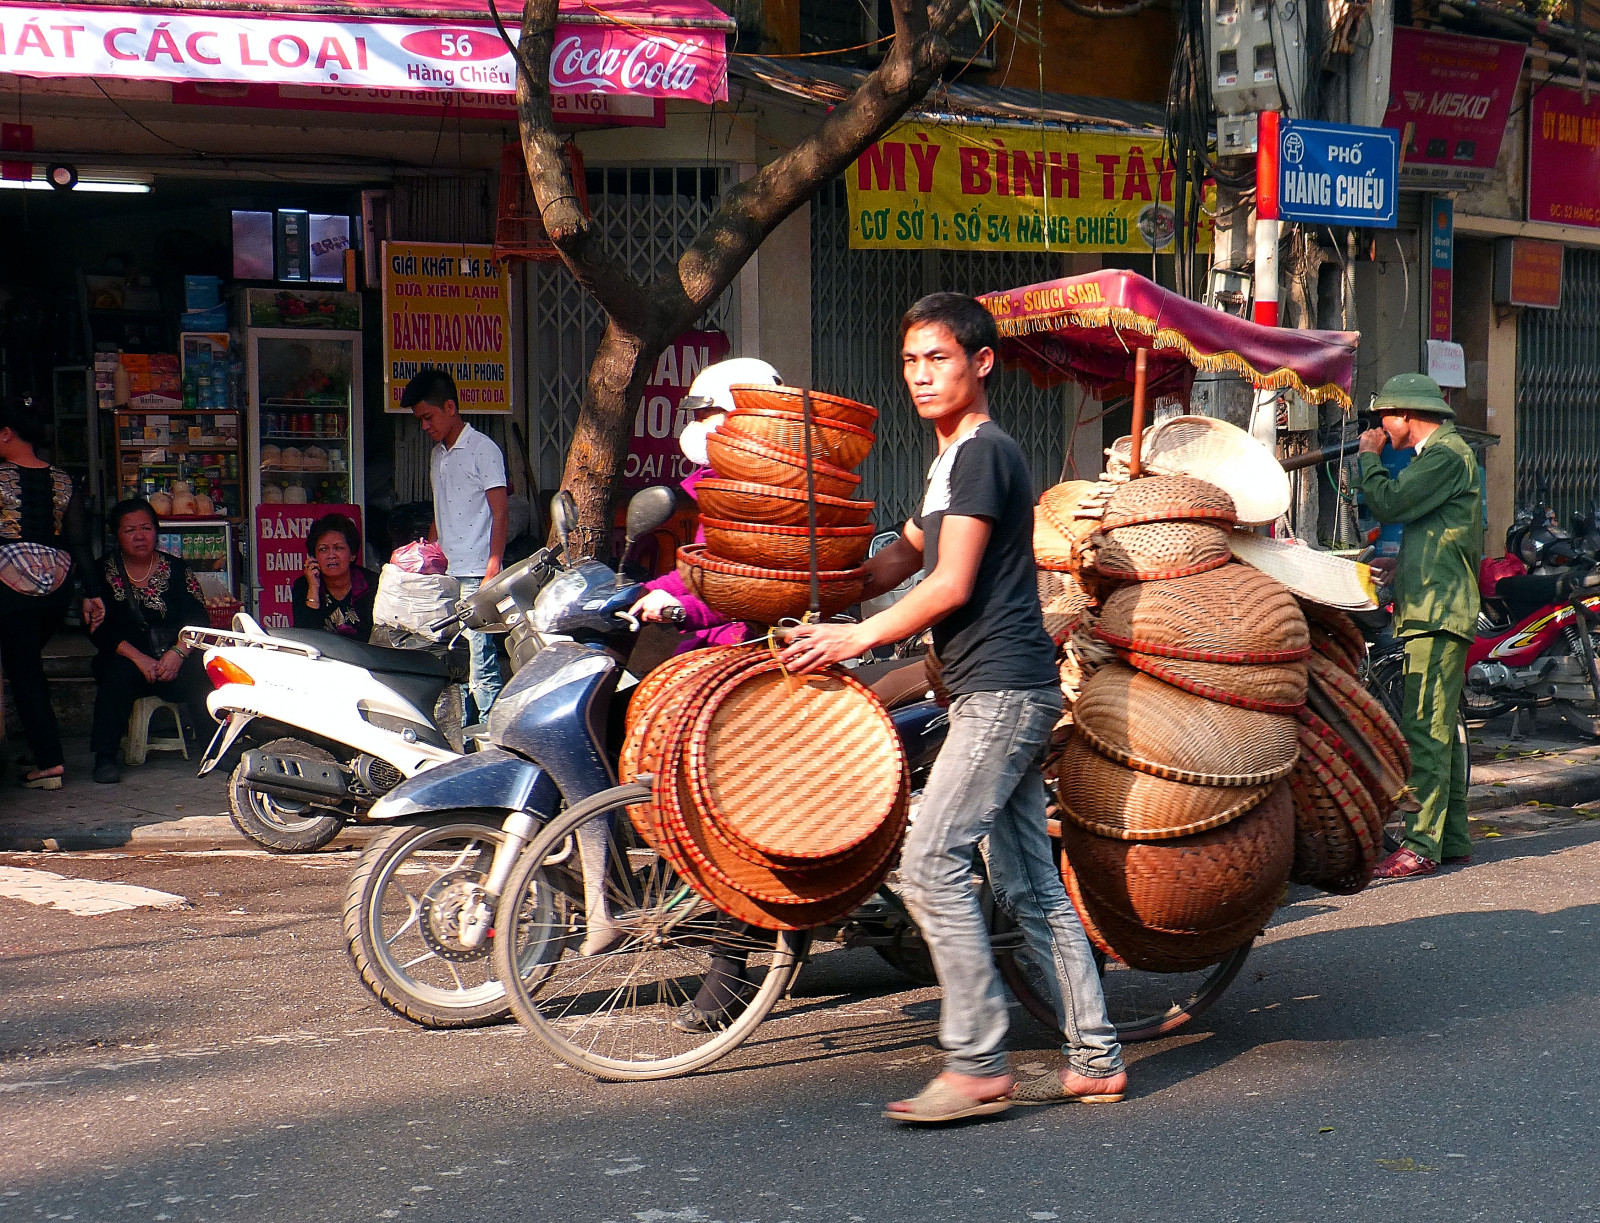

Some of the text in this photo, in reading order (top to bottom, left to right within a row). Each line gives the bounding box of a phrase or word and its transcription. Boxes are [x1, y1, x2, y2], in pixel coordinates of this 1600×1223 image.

[103, 22, 222, 65] CÁC
[239, 33, 368, 81] LOẠI
[441, 33, 473, 57] 56
[407, 64, 510, 86] Hàng Chiếu
[1328, 142, 1363, 164] PHỐ
[858, 132, 1178, 202] MỲ BÌNH TÂY
[1284, 164, 1384, 210] HÀNG CHIẾU
[860, 198, 1128, 245] CƠ SỞ 1: SỐ 54 HÀNG CHIẾU
[392, 250, 418, 276] GIẢI
[421, 253, 454, 278] KHÁT
[426, 282, 460, 298] XIÊM
[464, 285, 499, 301] LẠNH
[1024, 287, 1065, 312] SOUCI
[1067, 282, 1106, 304] SARL
[393, 301, 503, 352] BÁNH BAO NÓNG
[392, 357, 418, 380] BÁNH
[456, 355, 472, 381] HẢI
[474, 357, 504, 381] PHÒNG
[460, 388, 479, 405] NGỌT
[482, 385, 492, 403] CÓ
[266, 548, 302, 571] BÁNH
